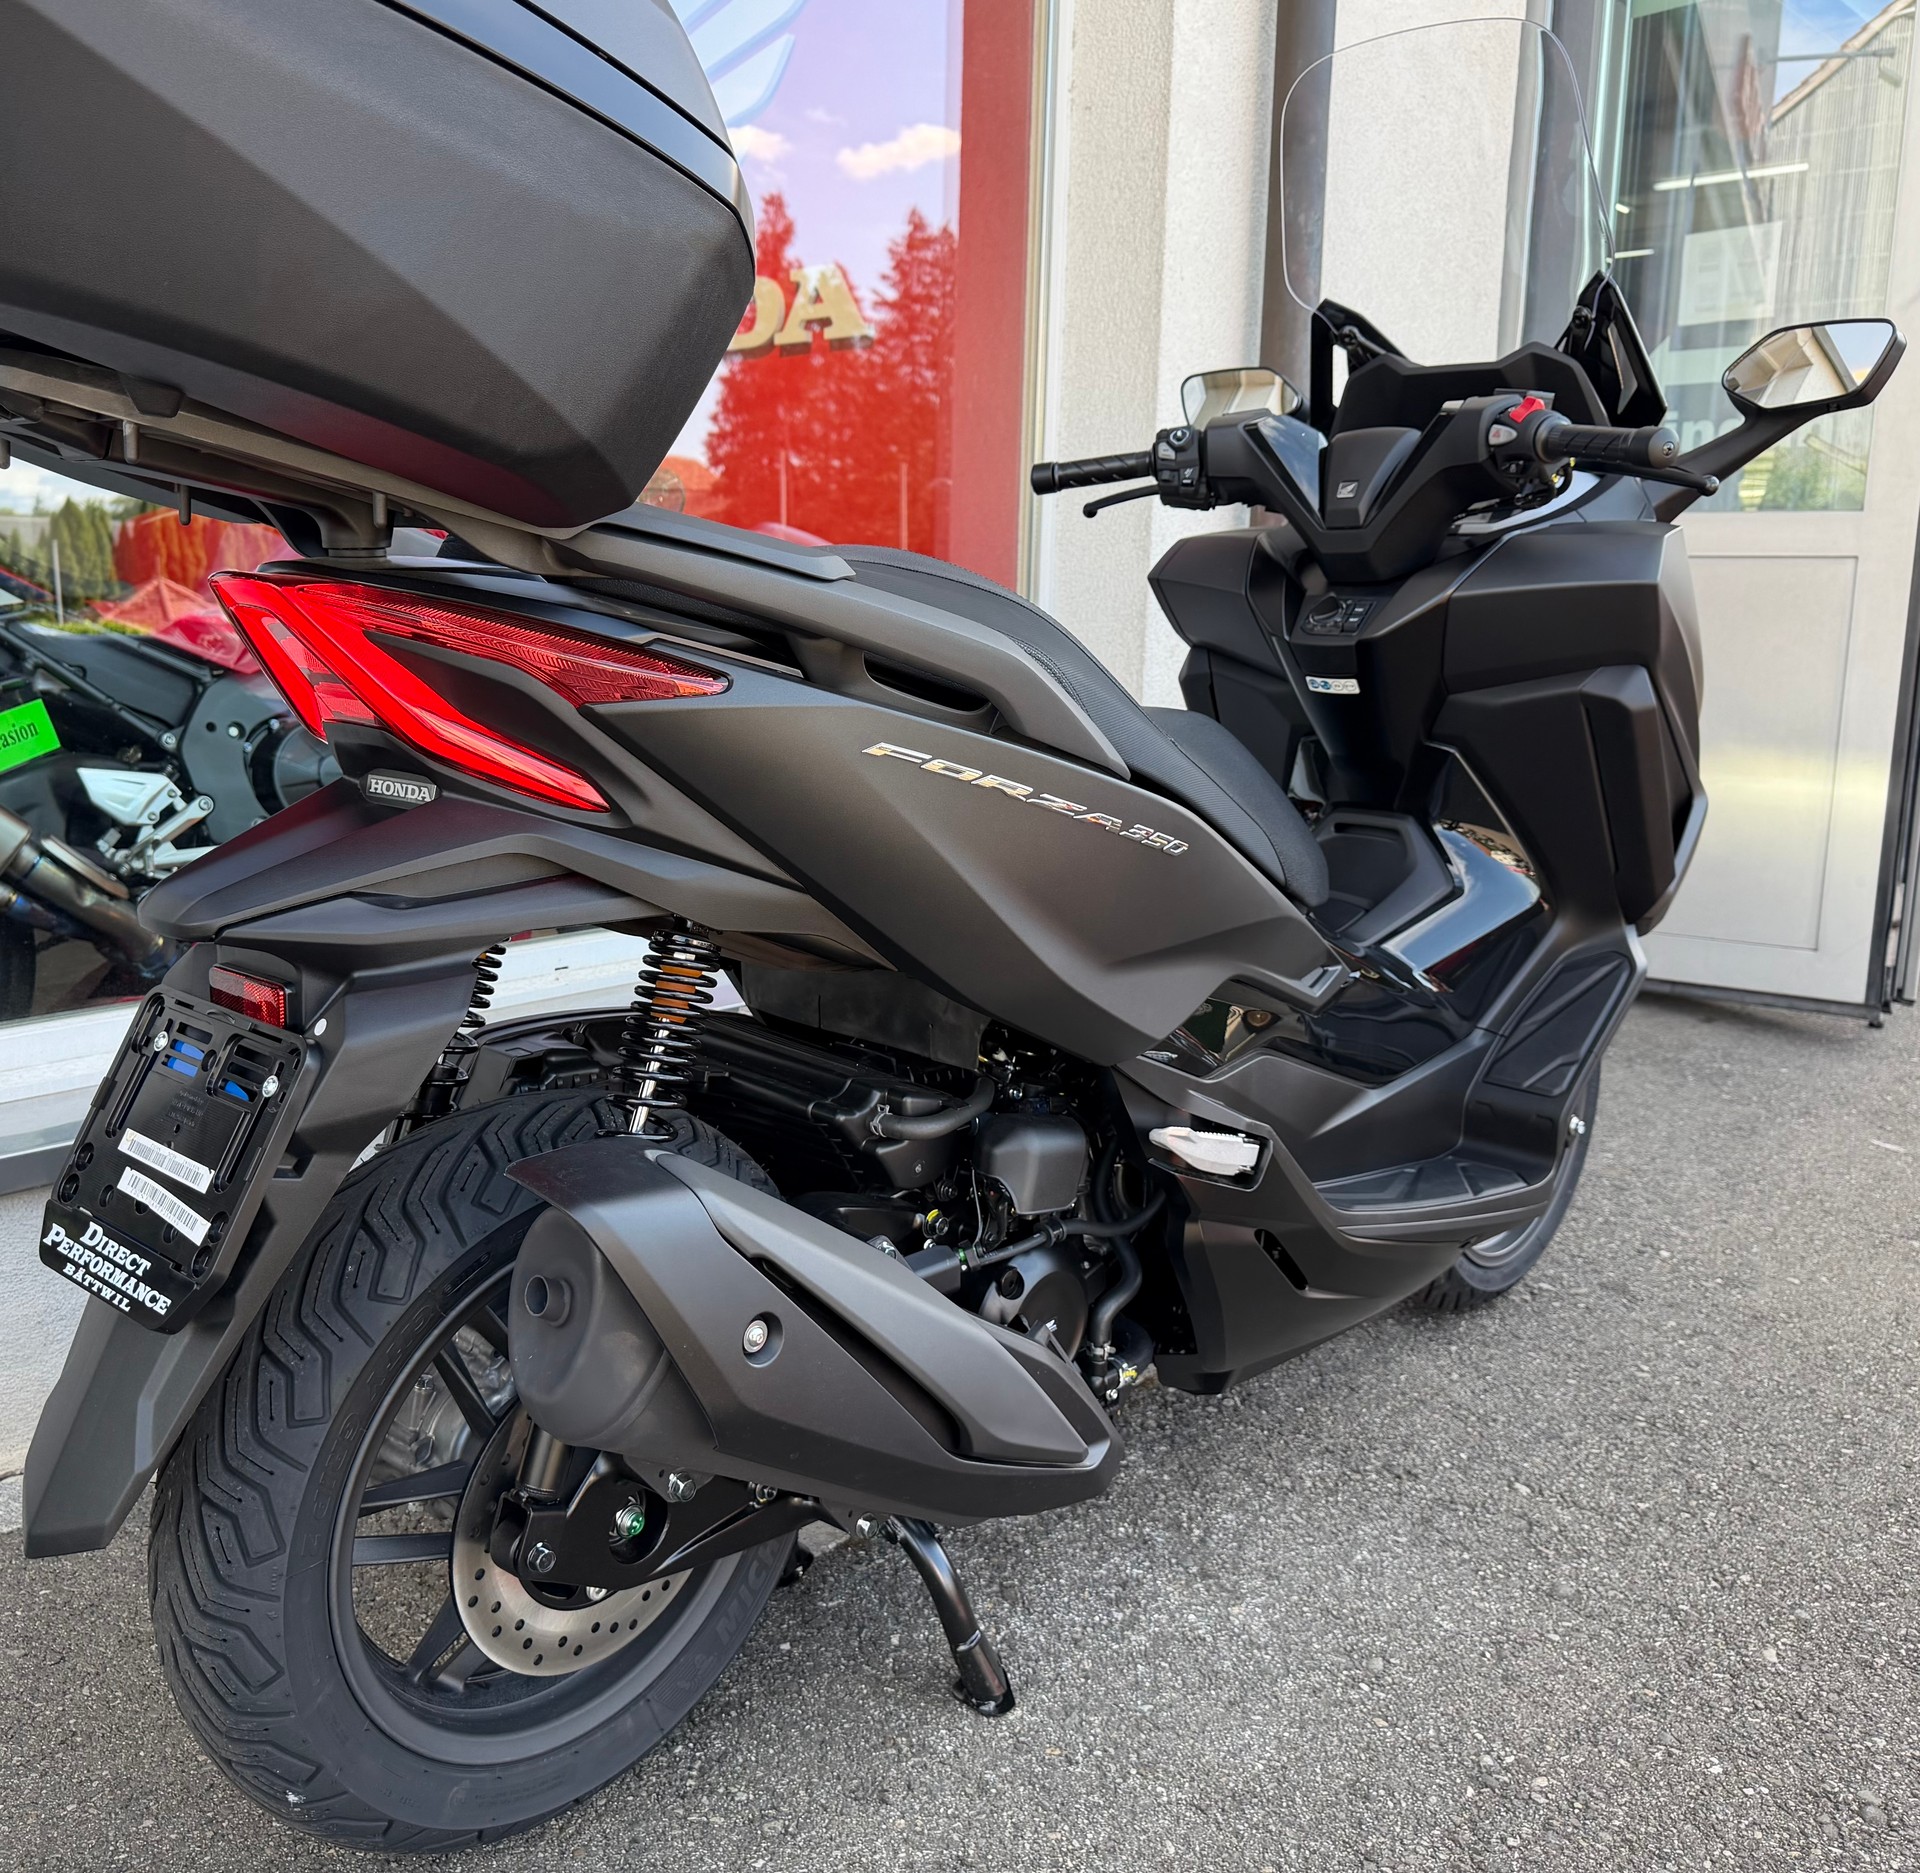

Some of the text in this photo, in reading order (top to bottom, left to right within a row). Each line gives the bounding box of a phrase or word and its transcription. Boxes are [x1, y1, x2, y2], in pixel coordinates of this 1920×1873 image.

[0, 722, 39, 750] asion
[369, 779, 432, 801] HONDA
[861, 742, 1190, 857] FORZA 350
[42, 1222, 172, 1316] PERFORMANCE
[80, 1221, 152, 1277] DIRECT
[62, 1262, 132, 1312] BÄTTWIL
